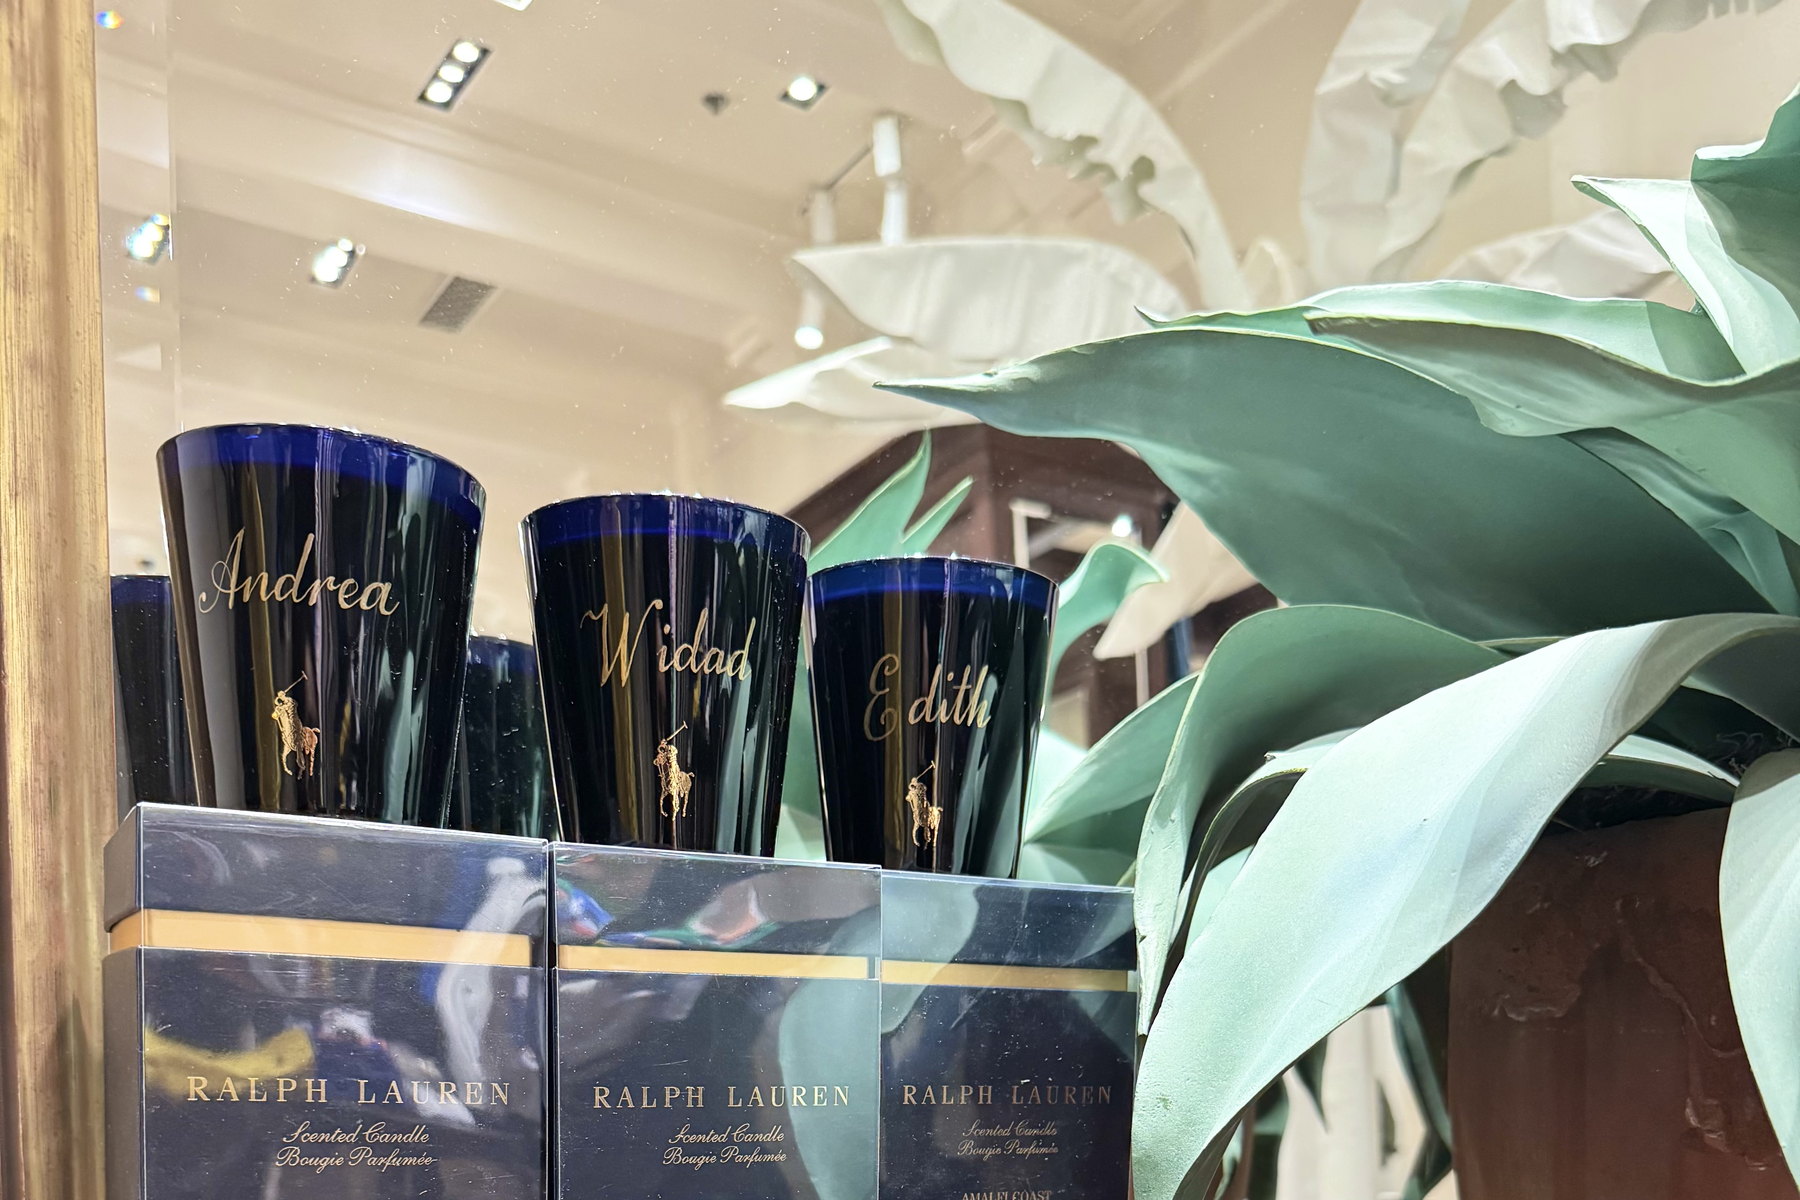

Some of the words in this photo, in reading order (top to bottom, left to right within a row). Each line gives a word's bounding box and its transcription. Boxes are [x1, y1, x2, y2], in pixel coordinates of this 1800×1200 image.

[199, 526, 400, 616] Andrea
[580, 599, 756, 688] Widad
[863, 653, 993, 742] Edith
[187, 1076, 328, 1103] RALPH
[357, 1079, 511, 1106] LAUREN
[593, 1086, 705, 1109] RALPH
[727, 1085, 850, 1108] LAUREN
[902, 1085, 993, 1106] RALPH
[1010, 1085, 1112, 1106] LAUREN
[283, 1120, 360, 1144] Scented
[362, 1121, 430, 1145] Candle
[668, 1123, 728, 1145] Scented
[730, 1123, 785, 1143] Candle
[962, 1119, 1014, 1138] Scented
[1014, 1120, 1058, 1137] Candle
[275, 1147, 345, 1174] Bougie
[348, 1146, 434, 1173] Parfumée
[662, 1146, 718, 1171] Bougie
[720, 1145, 788, 1169] Parfumée
[957, 1139, 1002, 1161] Bougie
